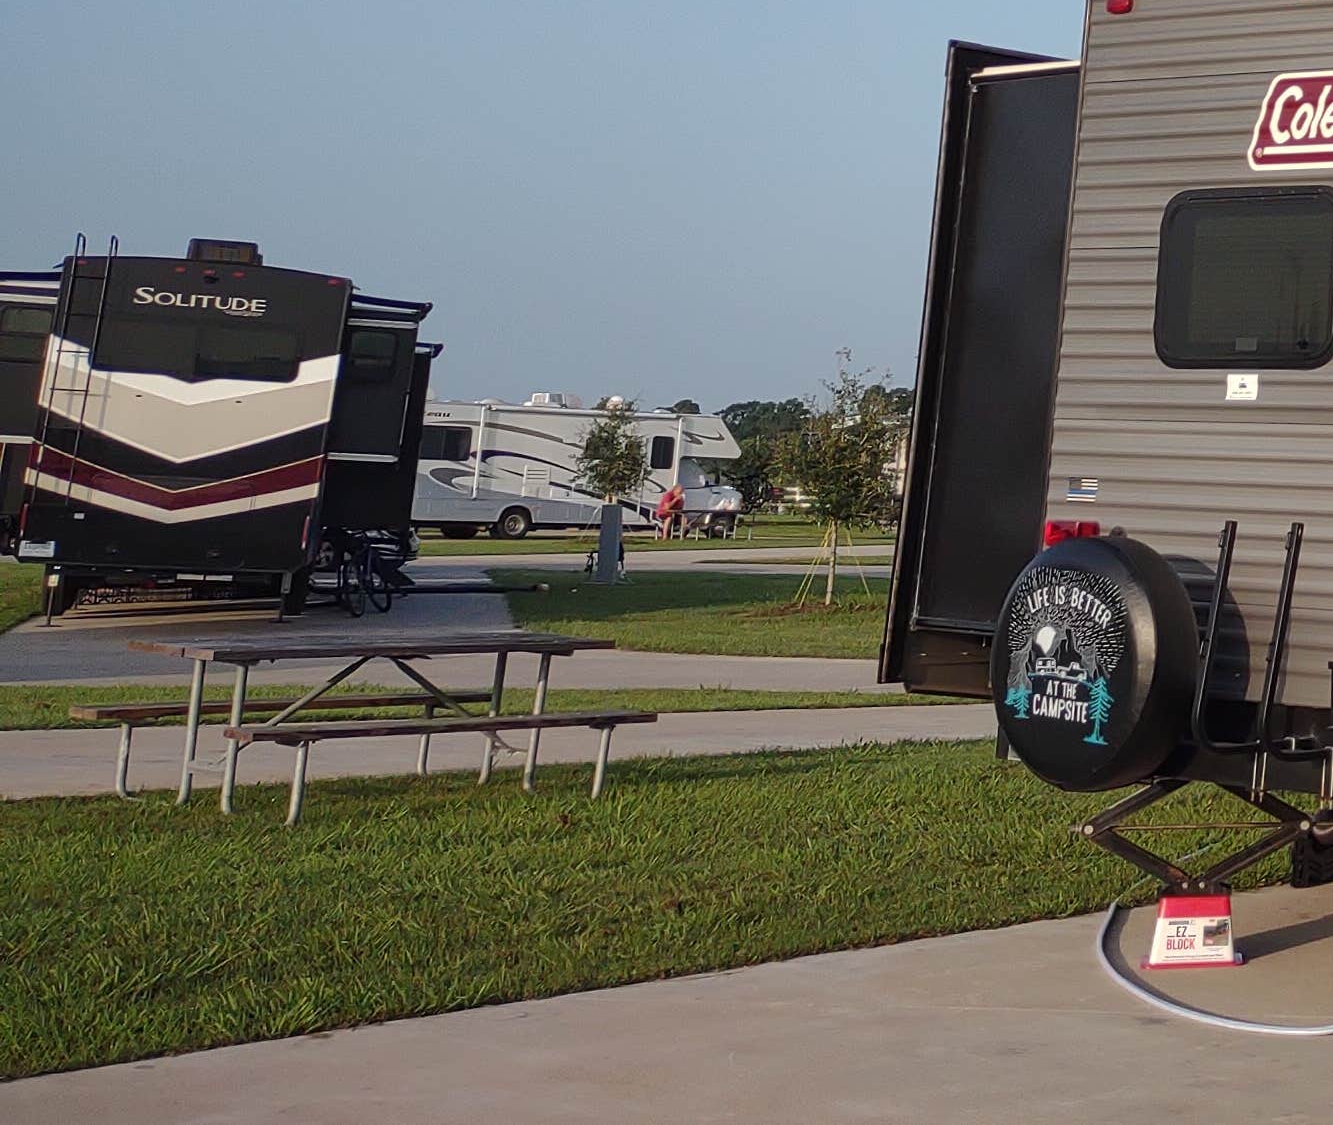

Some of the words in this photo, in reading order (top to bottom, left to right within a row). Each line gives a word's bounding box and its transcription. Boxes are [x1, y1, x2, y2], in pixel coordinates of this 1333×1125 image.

[132, 286, 267, 313] SOLITUDE
[1026, 586, 1051, 614] LIFE
[1054, 585, 1066, 605] IS
[1071, 587, 1112, 629] BETTER
[1046, 679, 1061, 696] AT
[1061, 682, 1077, 700] THE
[1032, 693, 1089, 724] CAMPSITE
[1176, 925, 1188, 938] EZ
[1166, 938, 1196, 951] BLOCK
